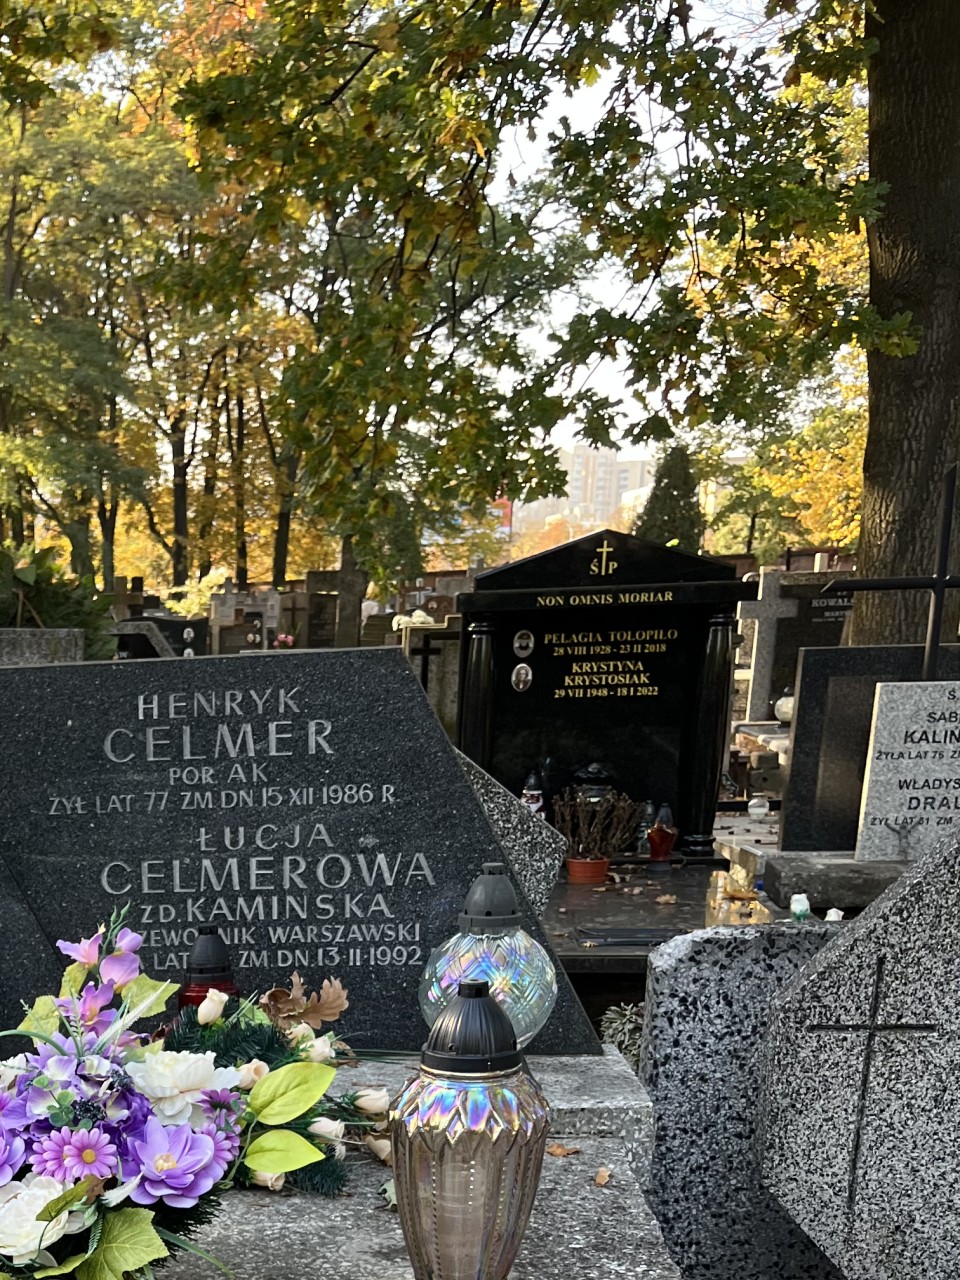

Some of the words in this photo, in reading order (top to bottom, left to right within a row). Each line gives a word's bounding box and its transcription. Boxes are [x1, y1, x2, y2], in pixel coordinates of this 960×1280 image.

[536, 596, 565, 607] NON
[569, 594, 613, 605] OMNIS
[618, 591, 673, 603] MORIAR
[544, 633, 602, 644] PELAGIA
[553, 647, 565, 656] 28
[569, 645, 586, 655] VIII
[590, 645, 611, 655] 1928
[620, 645, 631, 654] 23
[634, 645, 641, 653] II
[644, 644, 666, 653] 2018
[572, 661, 644, 673] KRYSTYNA
[565, 673, 650, 686] KRYSTOSIAK
[554, 690, 565, 698] 29
[569, 689, 583, 698] VII
[587, 688, 608, 697] 1948
[617, 688, 628, 696] 18
[637, 687, 659, 696] 2022
[138, 687, 302, 720] HENRYK
[927, 711, 960, 723] SAB
[103, 719, 334, 763] CELMER
[908, 751, 928, 760] LAT
[95, 794, 136, 814] LAT
[143, 791, 169, 811] 77
[261, 786, 283, 807] 15
[322, 783, 374, 805] 1986
[196, 823, 334, 851] ŁUCJA
[100, 852, 436, 895] CELMEROWA
[268, 923, 420, 945] WARSZAWSKI
[154, 952, 190, 970] LAT
